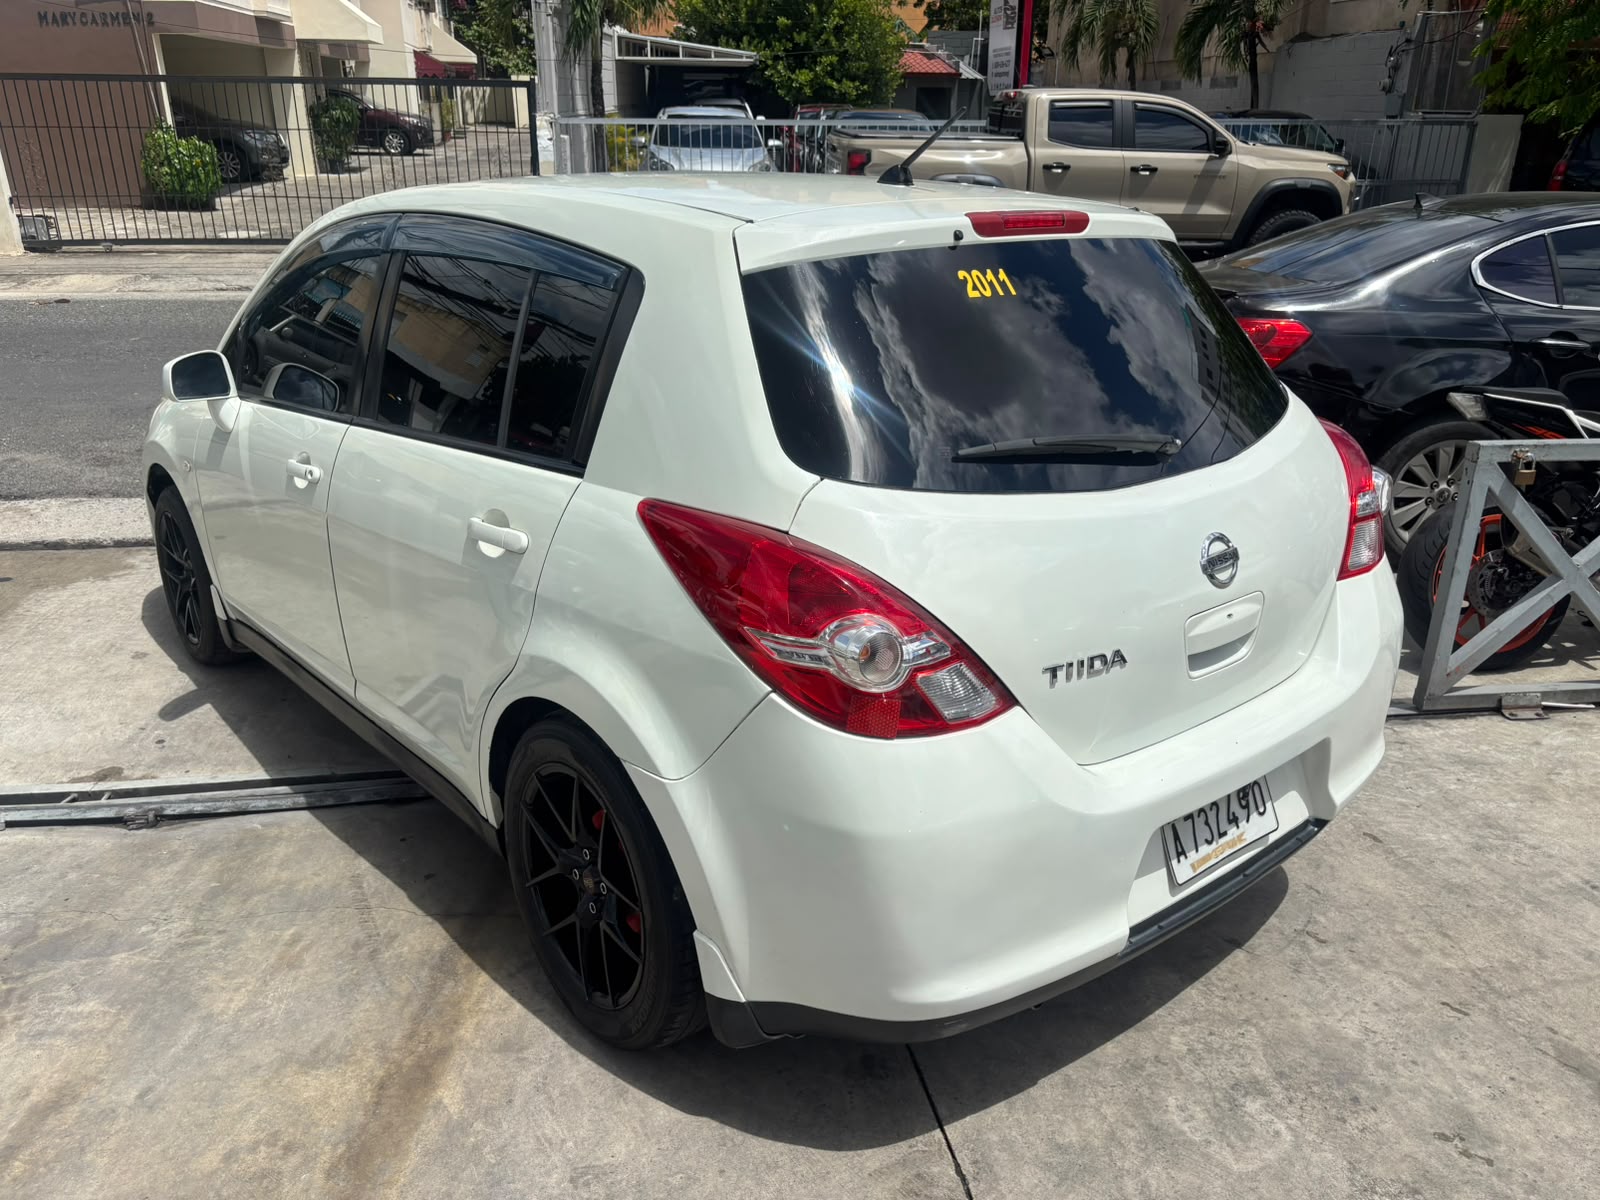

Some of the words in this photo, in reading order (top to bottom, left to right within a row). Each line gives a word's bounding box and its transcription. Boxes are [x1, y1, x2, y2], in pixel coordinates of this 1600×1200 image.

[957, 268, 1017, 298] 2011
[1206, 550, 1237, 569] NISSAN
[1041, 648, 1128, 689] TIIDA
[1170, 780, 1267, 864] A732490
